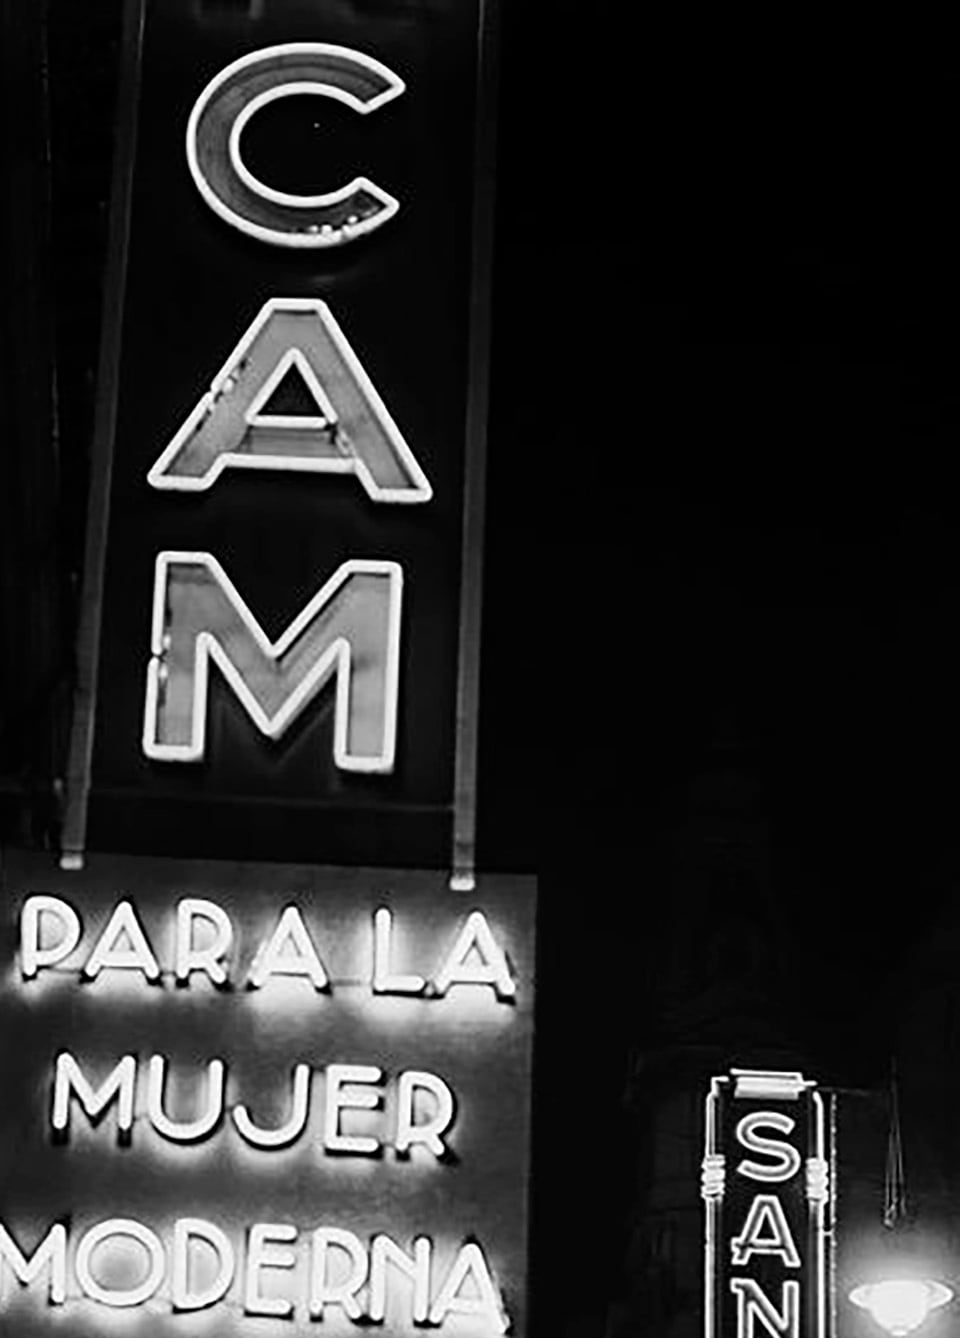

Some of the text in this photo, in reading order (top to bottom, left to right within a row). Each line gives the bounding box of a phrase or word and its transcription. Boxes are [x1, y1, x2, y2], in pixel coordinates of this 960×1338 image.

[143, 42, 432, 774] CAM
[19, 896, 515, 1001] PARA LA
[51, 1052, 456, 1160] MUJER
